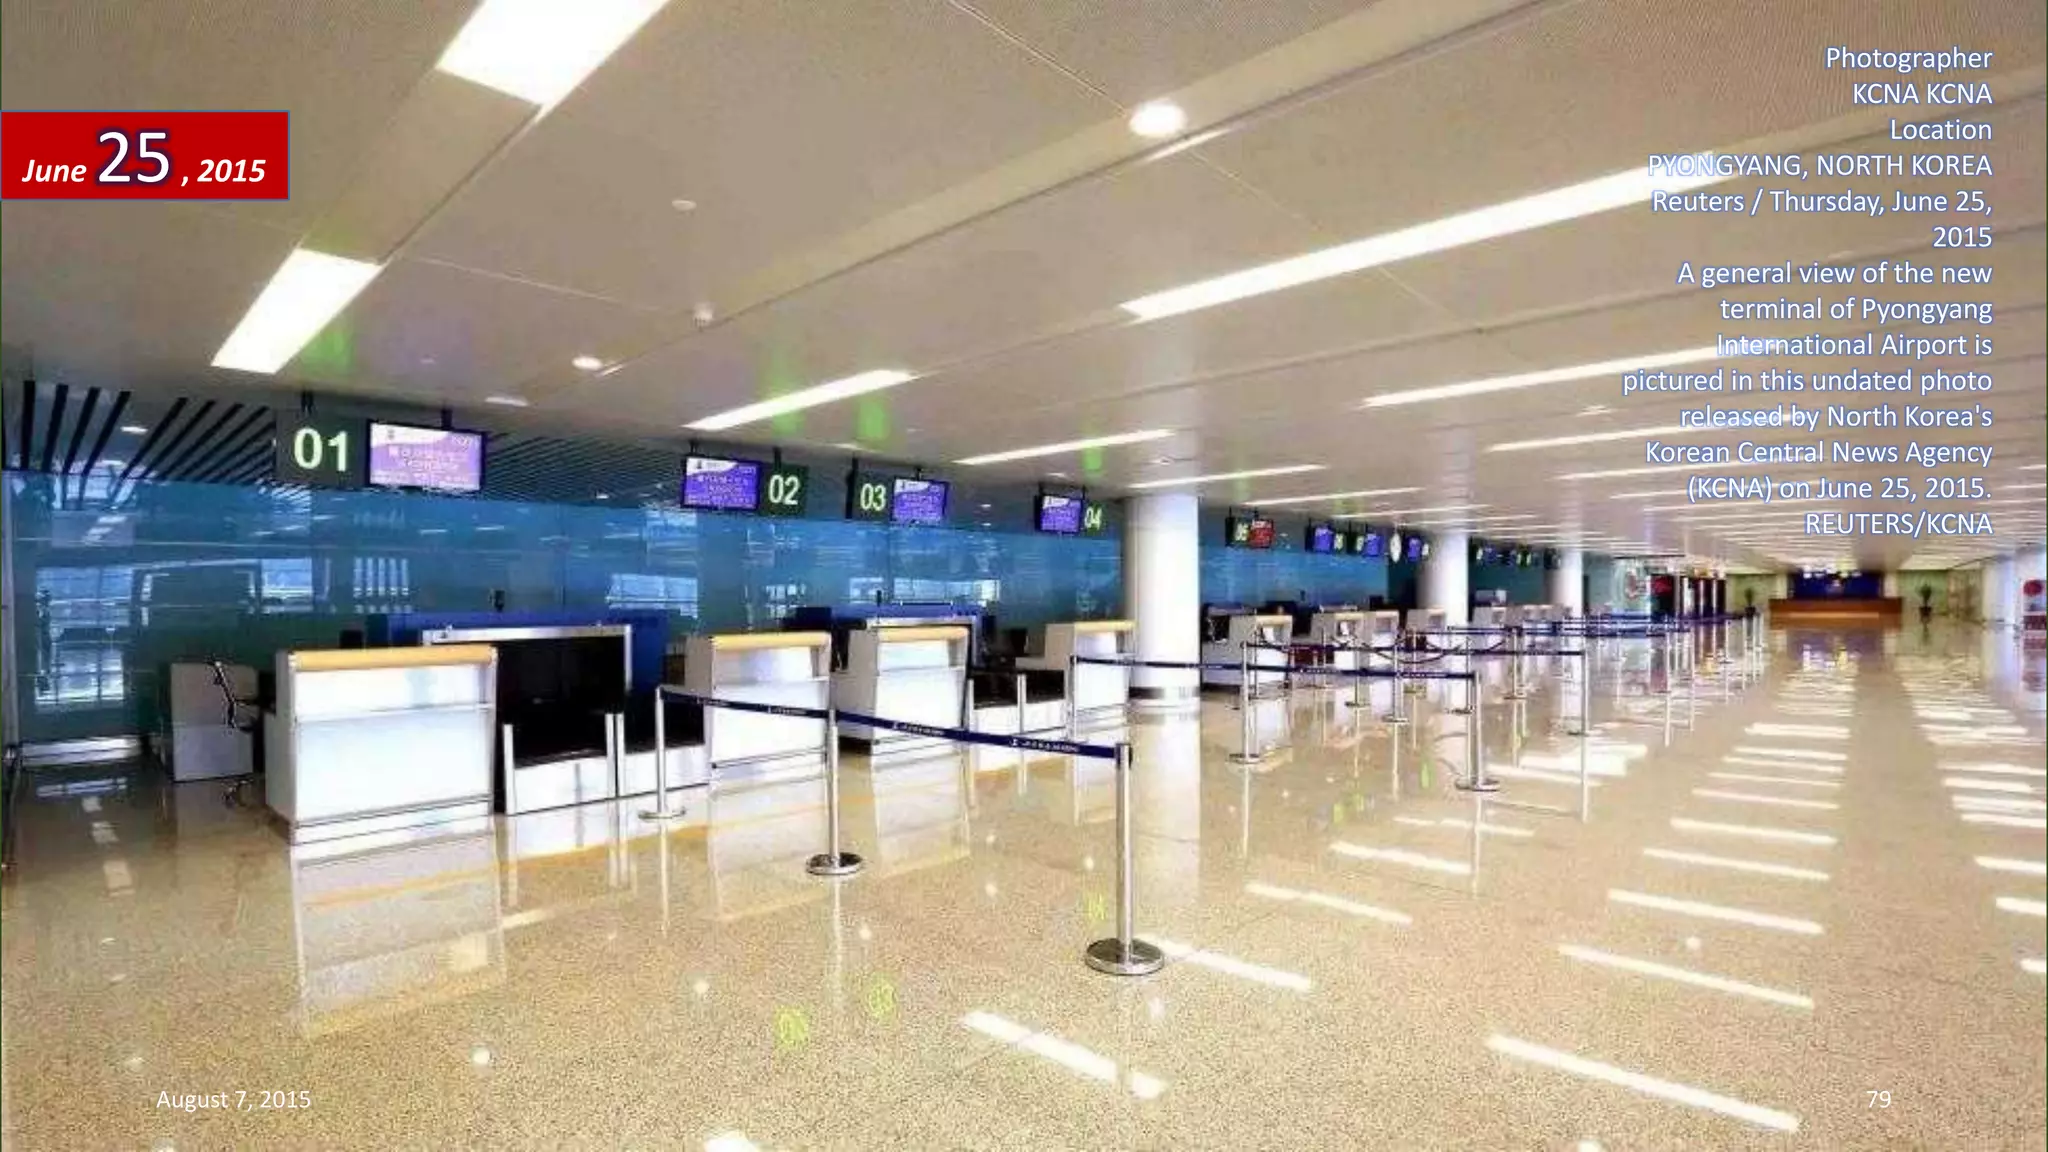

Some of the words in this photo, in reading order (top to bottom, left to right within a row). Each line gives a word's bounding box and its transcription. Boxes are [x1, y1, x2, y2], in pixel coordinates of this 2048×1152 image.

[293, 427, 348, 473] 01
[768, 475, 800, 505] 02
[860, 484, 886, 511] 03
[1084, 507, 1102, 528] 04
